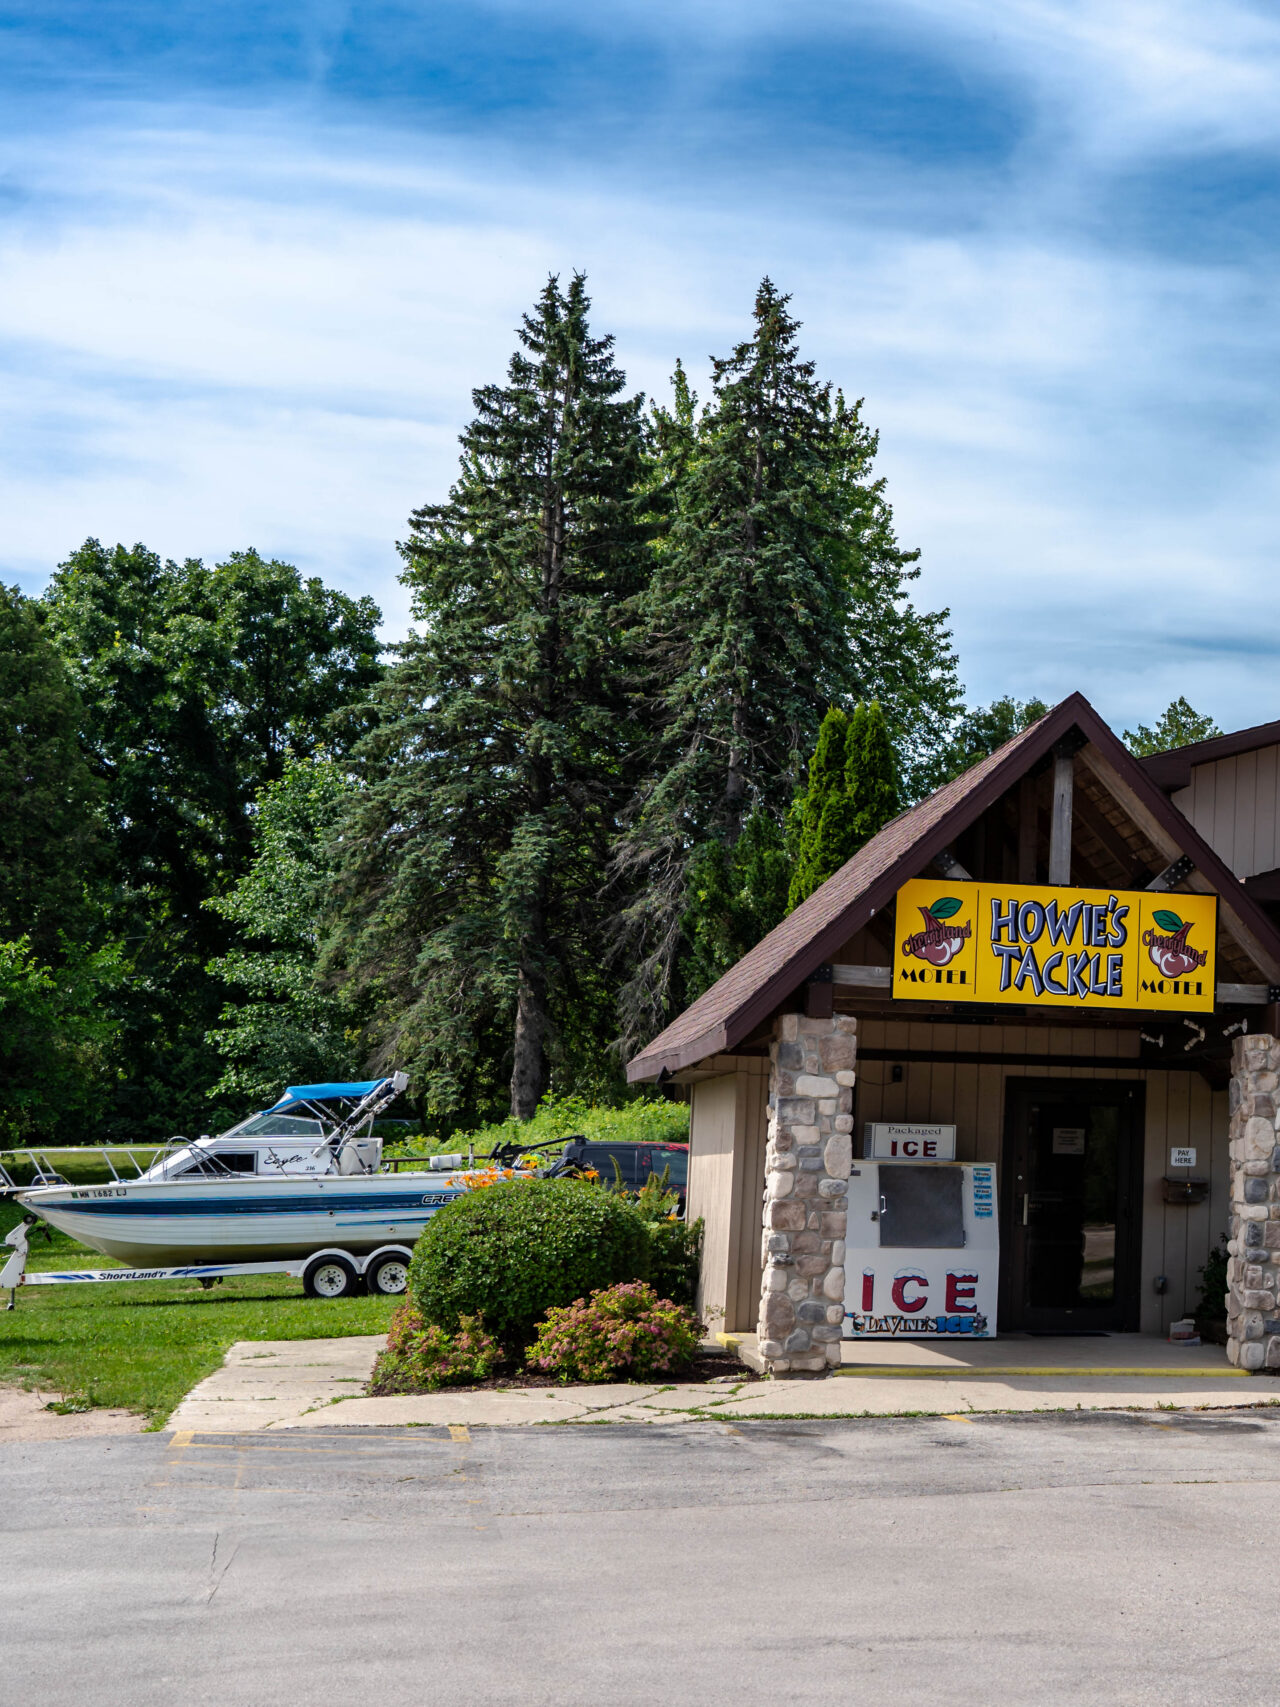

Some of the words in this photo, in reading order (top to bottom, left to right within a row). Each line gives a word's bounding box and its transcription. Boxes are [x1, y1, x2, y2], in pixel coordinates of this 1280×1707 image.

[902, 919, 972, 957] Cherryland
[990, 895, 1130, 947] HOWIE'S
[1142, 927, 1208, 966] Cherryland
[899, 967, 972, 986] MOTEL
[991, 943, 1123, 1000] TACKLE
[1140, 979, 1208, 997] MOTEL
[888, 1126, 942, 1136] Packaged
[890, 1139, 938, 1158] ICE
[861, 1267, 979, 1314] ICE
